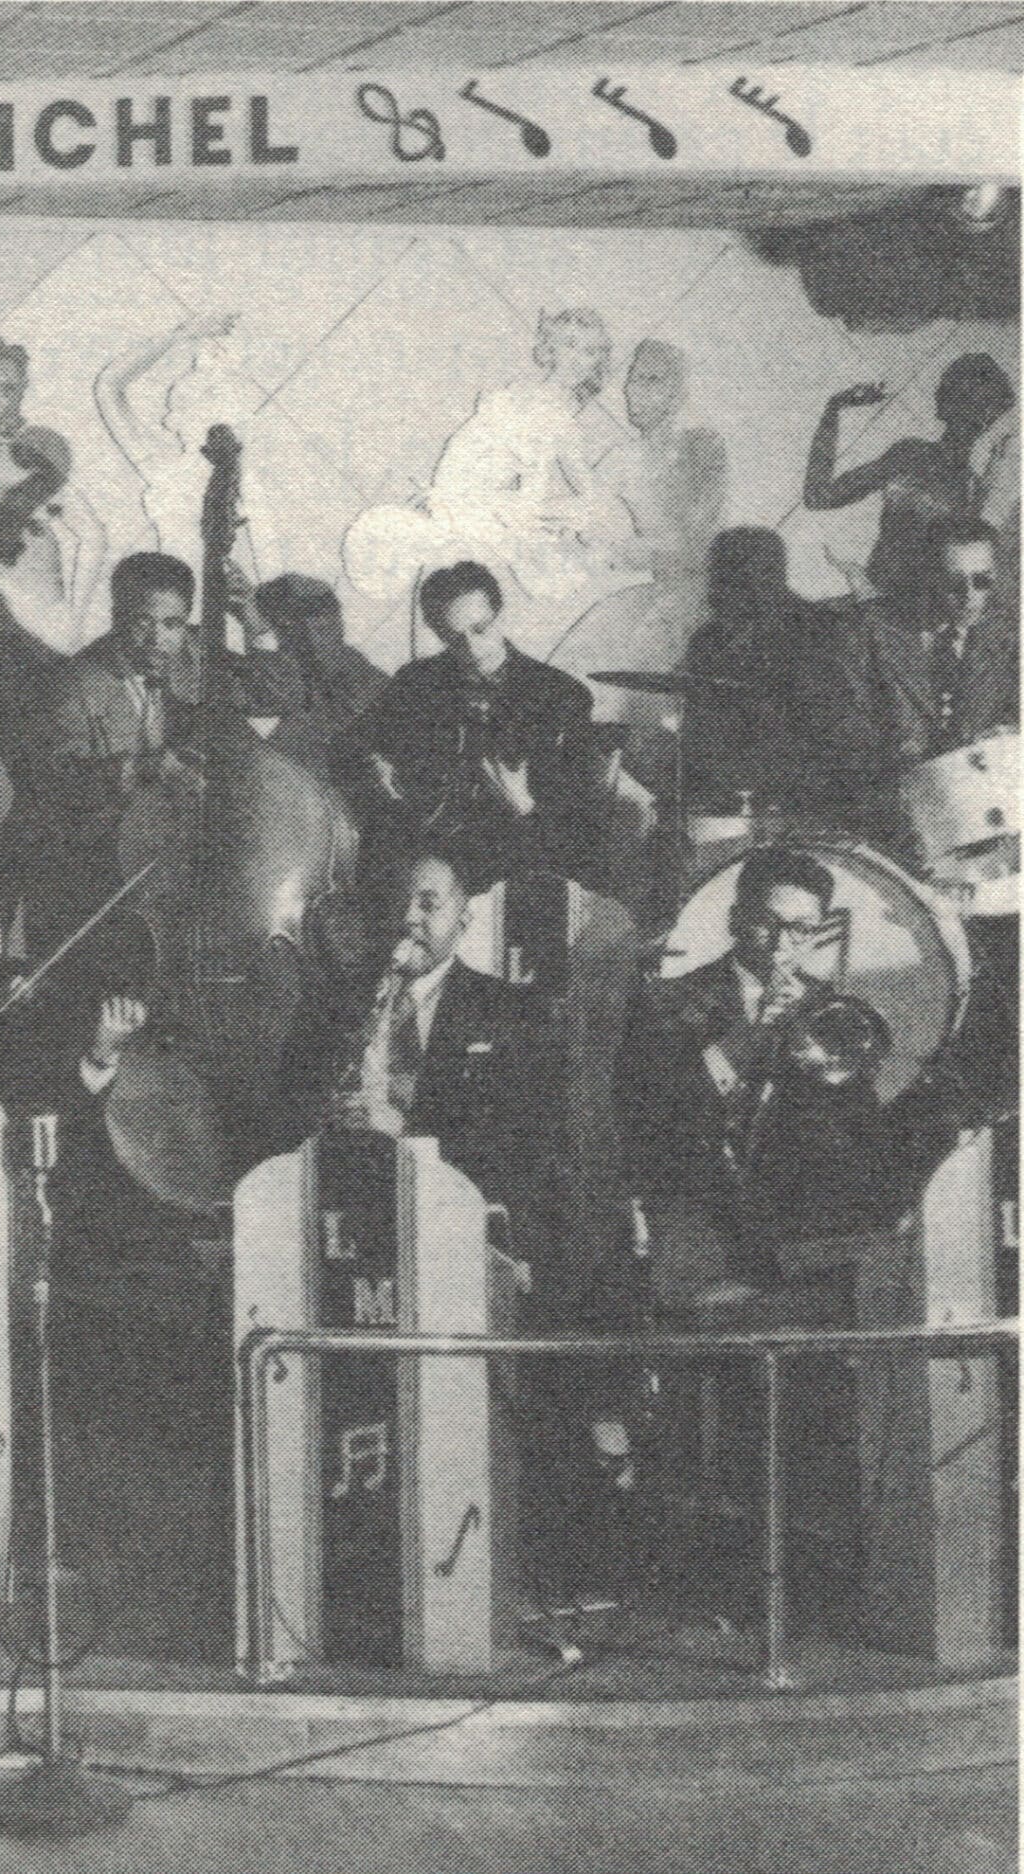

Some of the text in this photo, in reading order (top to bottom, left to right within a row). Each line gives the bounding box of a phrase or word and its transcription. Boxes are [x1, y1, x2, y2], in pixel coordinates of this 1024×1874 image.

[509, 946, 535, 984] L
[325, 1210, 356, 1259] L
[352, 1277, 397, 1324] M
